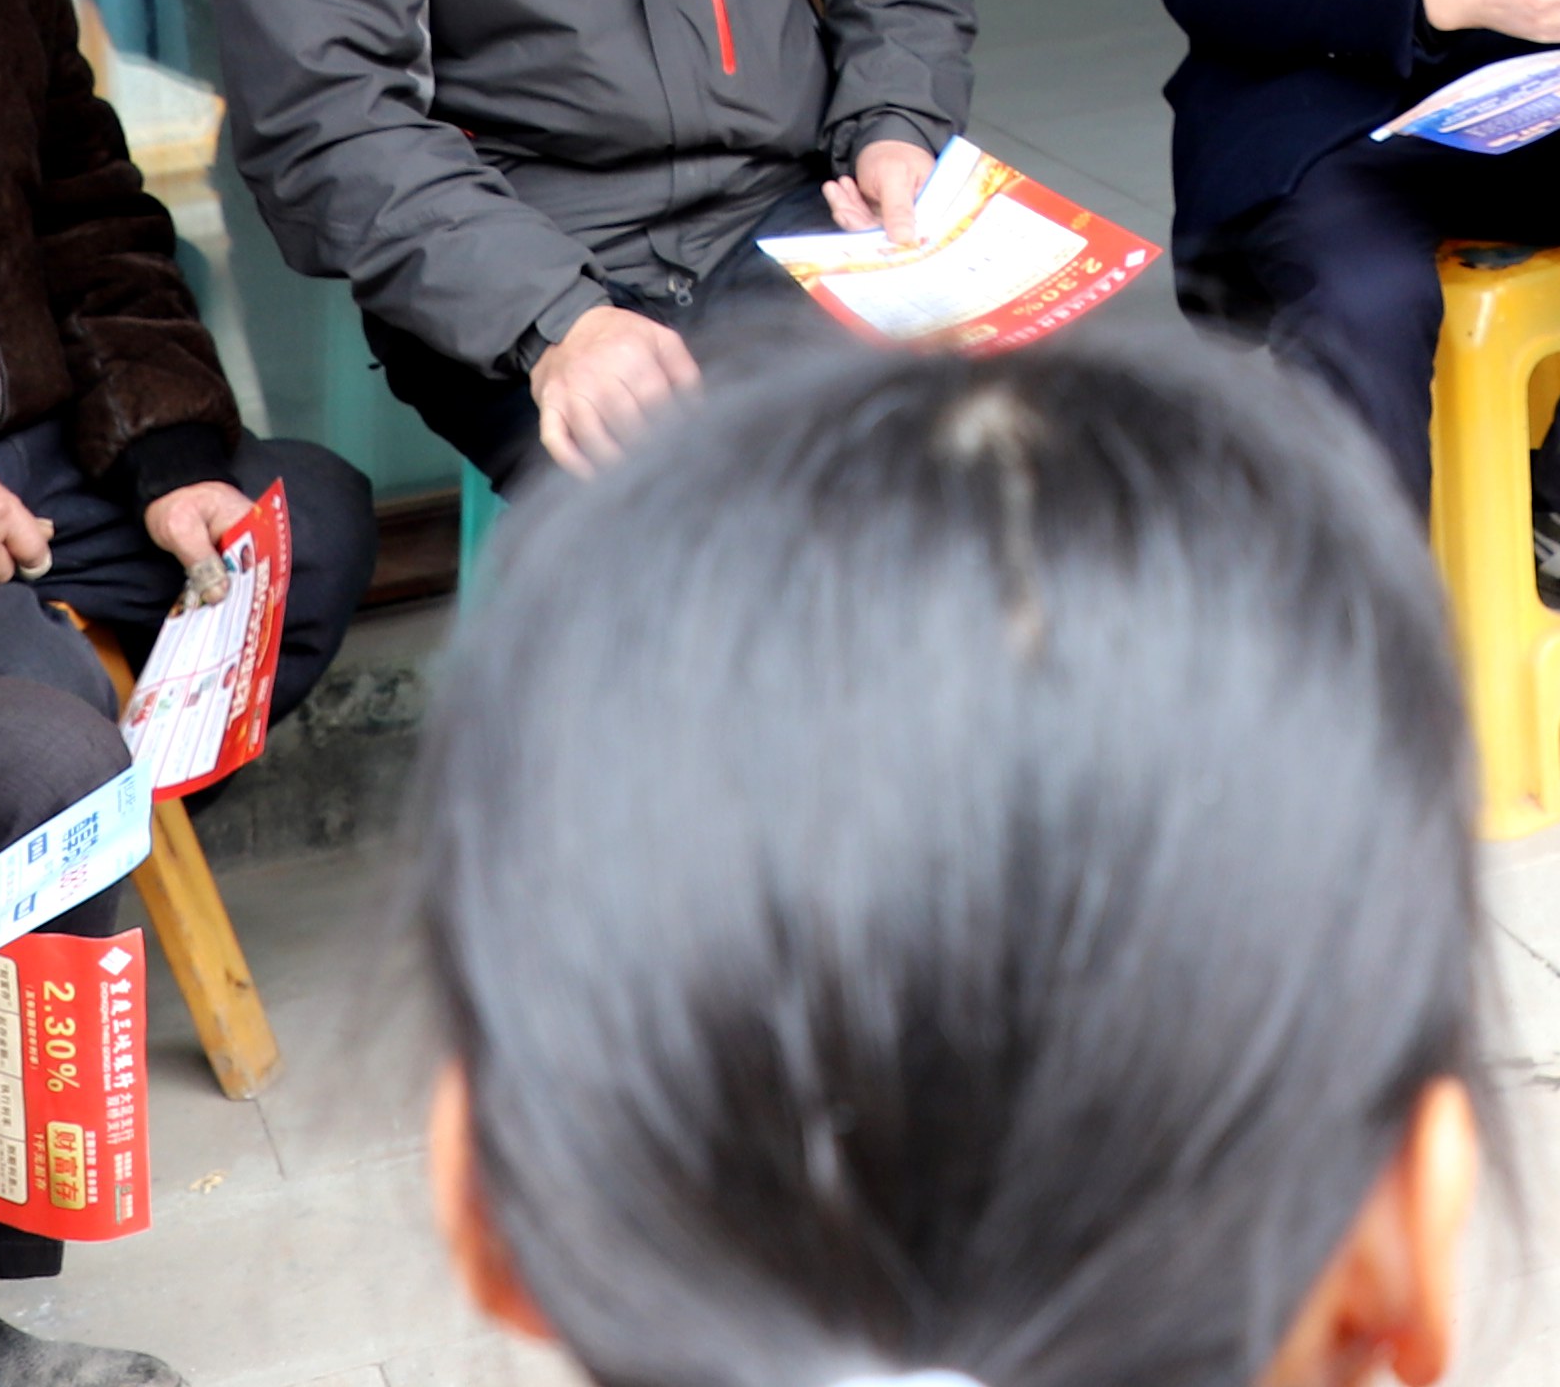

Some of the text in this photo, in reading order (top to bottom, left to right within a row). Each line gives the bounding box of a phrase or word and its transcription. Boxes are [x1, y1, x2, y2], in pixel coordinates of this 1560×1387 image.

[42, 980, 81, 1093] 2.30%
[52, 1130, 79, 1201] 财富存
